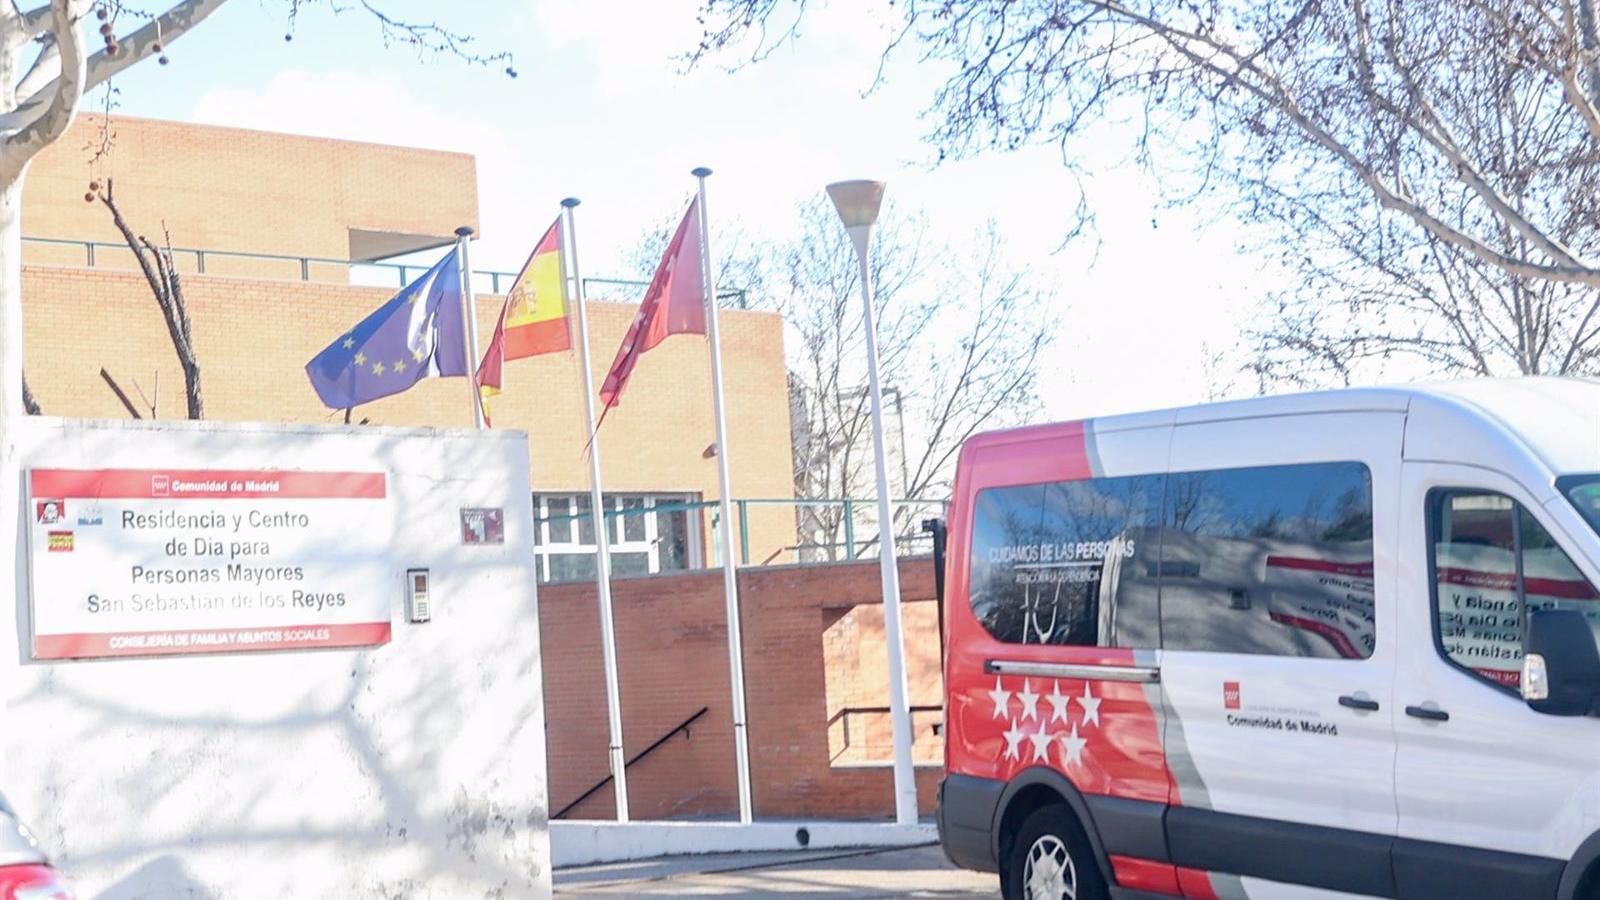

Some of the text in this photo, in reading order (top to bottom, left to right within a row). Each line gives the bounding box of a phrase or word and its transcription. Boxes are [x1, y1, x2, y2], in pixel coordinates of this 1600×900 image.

[172, 480, 280, 492] Comunidad de Madrid
[121, 509, 226, 529] Residencia
[232, 514, 242, 533] y
[248, 509, 309, 528] Centro
[165, 537, 187, 556] de
[230, 540, 270, 559] para
[991, 540, 1135, 562] CUIDAMOS DE LAS PERSOAS
[131, 564, 304, 586] Personas Mayores
[87, 595, 124, 614] San
[231, 592, 253, 610] de
[259, 591, 285, 609] los
[291, 589, 346, 612] Reyes
[175, 635, 190, 647] DE
[191, 631, 229, 646] FAMILIA
[228, 631, 238, 645] Y
[237, 630, 282, 645] ASUNTOS
[284, 628, 331, 643] SOCIALES
[1227, 713, 1338, 736] Comunidad de Madrid
